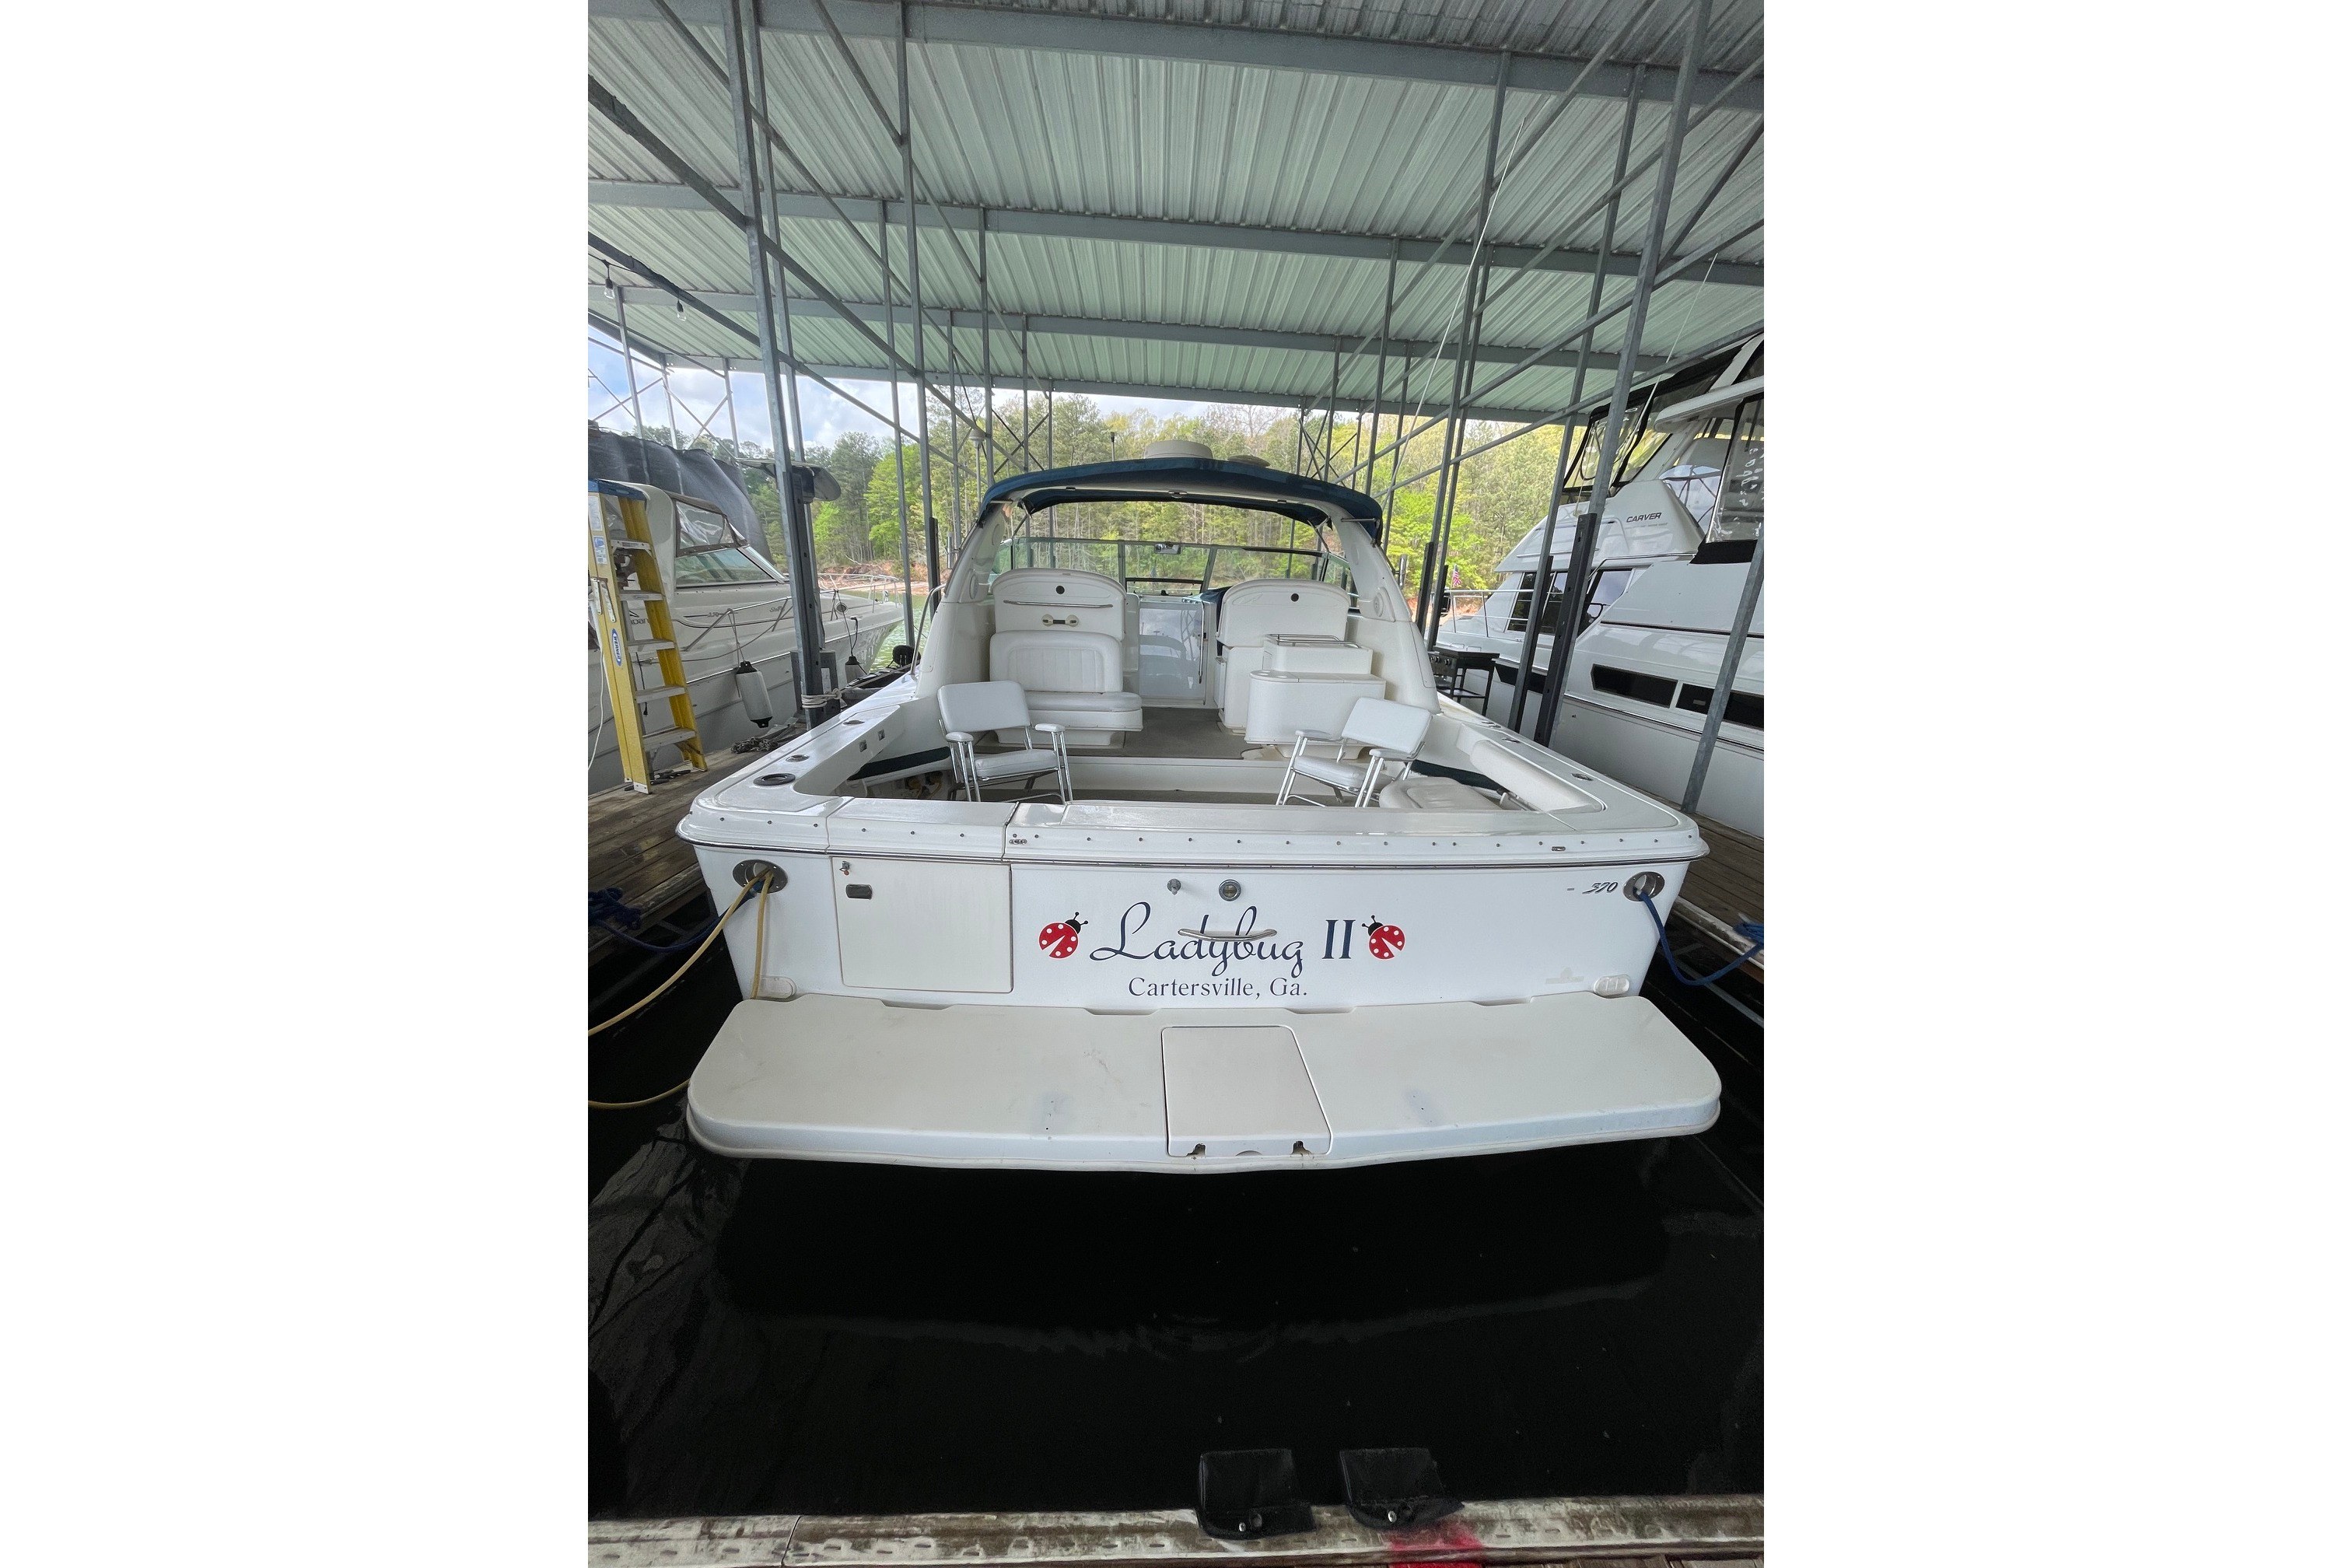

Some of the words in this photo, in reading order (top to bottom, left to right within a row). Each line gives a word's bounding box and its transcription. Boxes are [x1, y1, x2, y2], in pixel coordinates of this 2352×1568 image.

[1626, 512, 1662, 523] CARVER
[1582, 881, 1619, 894] 370
[1089, 901, 1304, 977] Ladybug
[1321, 919, 1356, 960] II
[1129, 977, 1260, 1000] Cartersville,
[1269, 977, 1307, 996] Ga.
